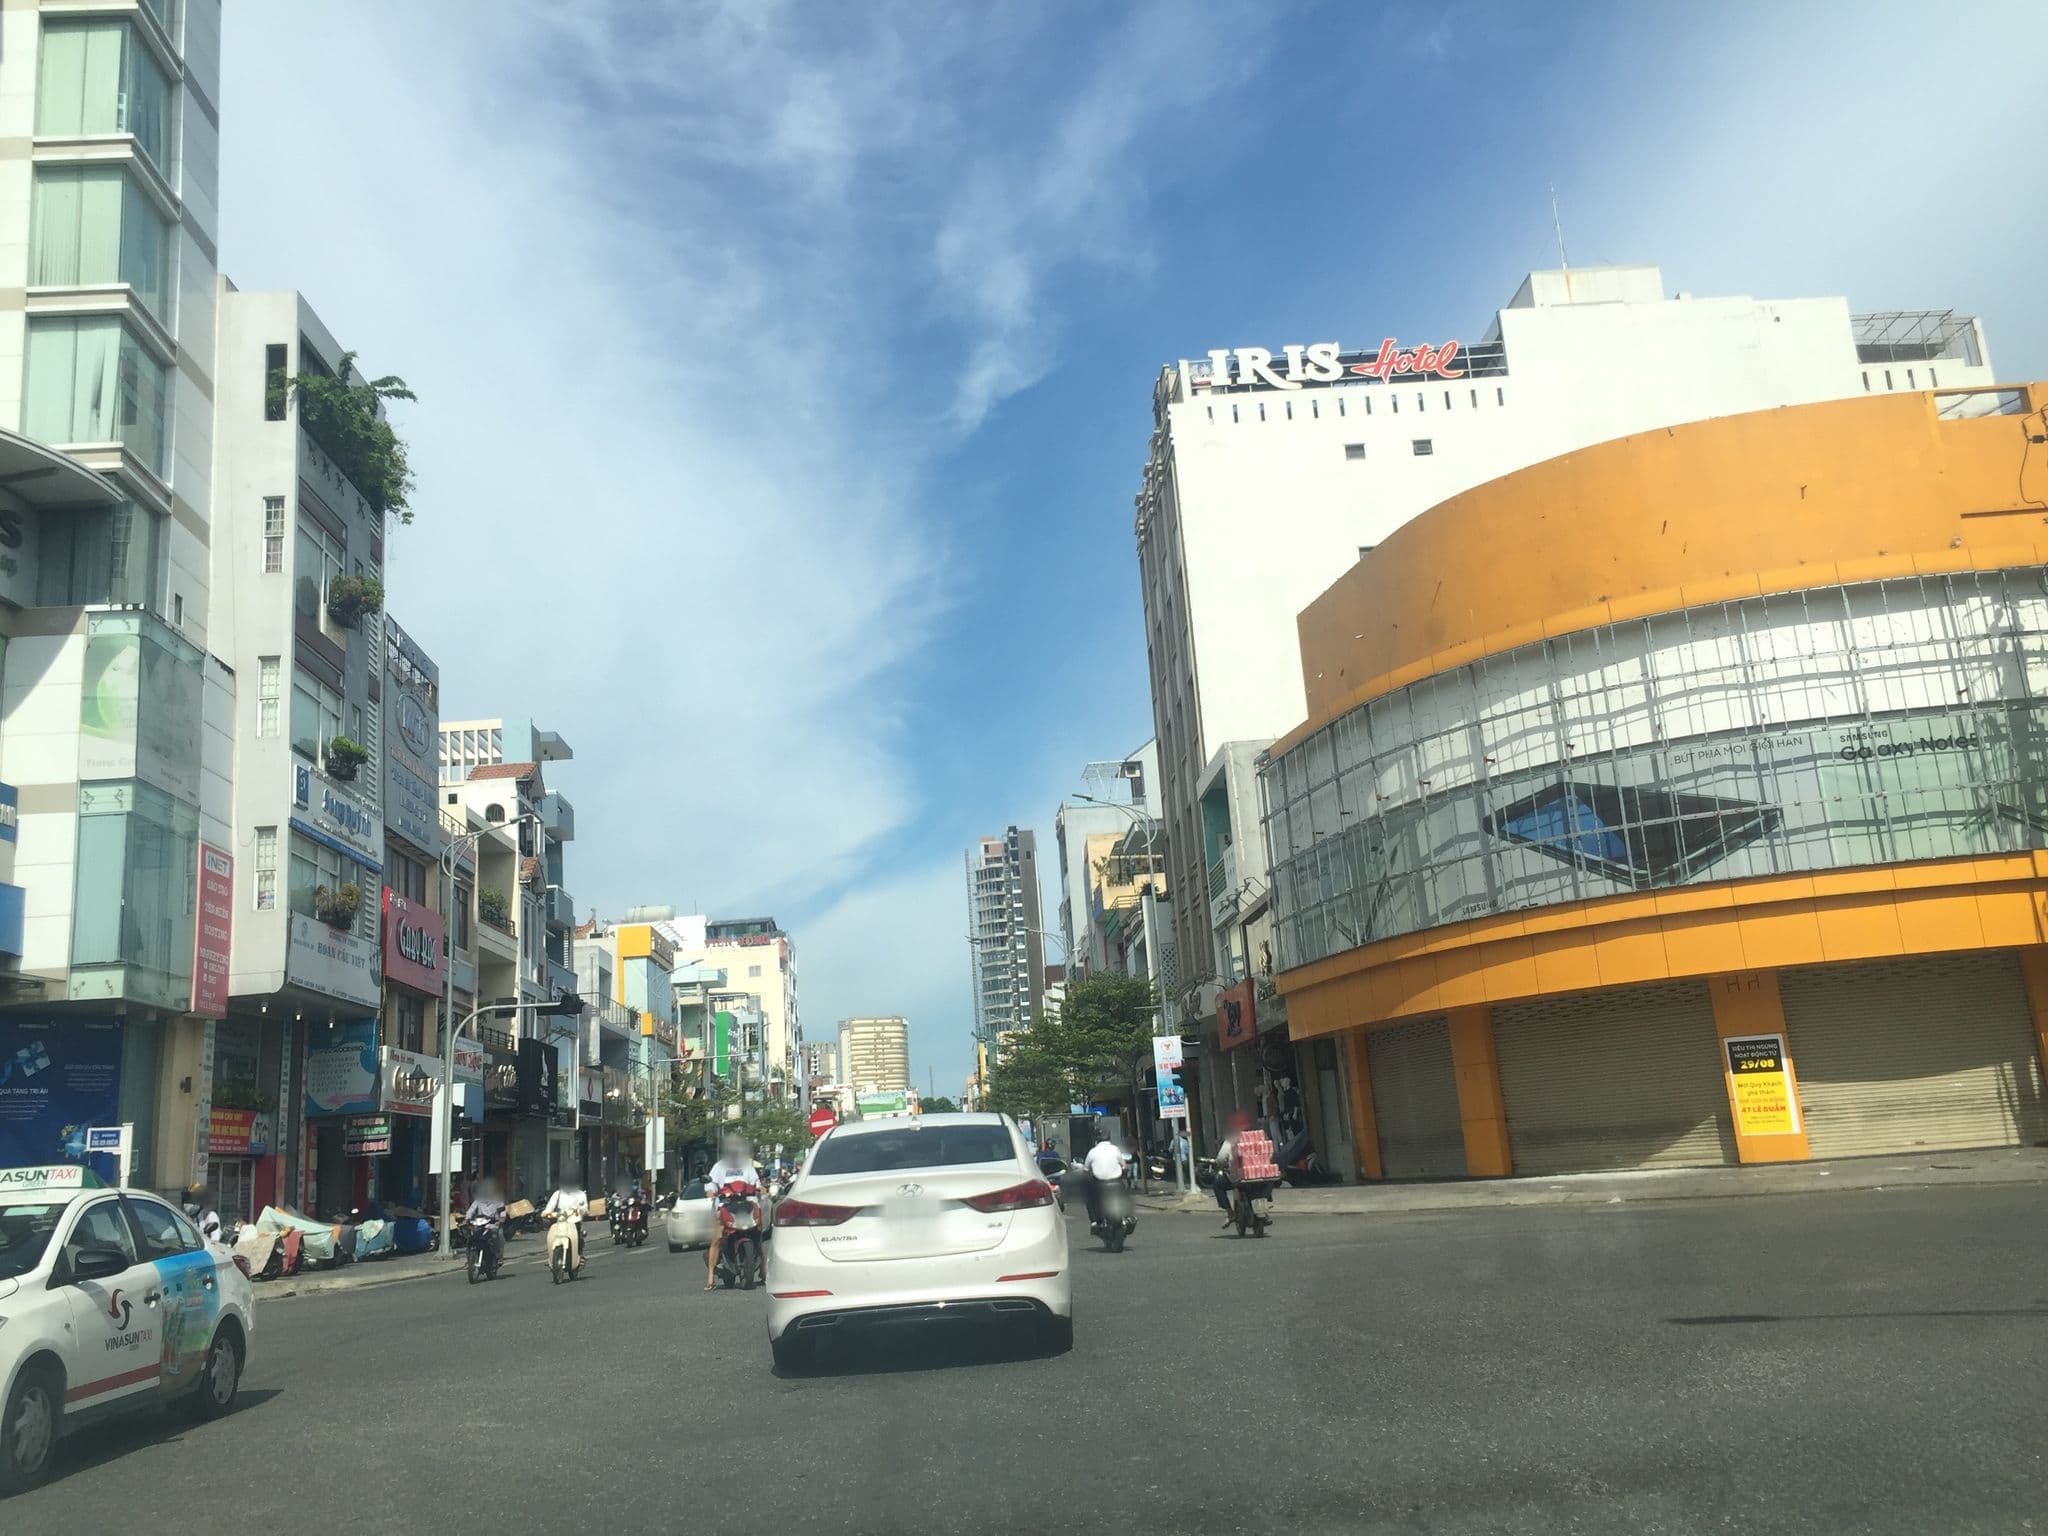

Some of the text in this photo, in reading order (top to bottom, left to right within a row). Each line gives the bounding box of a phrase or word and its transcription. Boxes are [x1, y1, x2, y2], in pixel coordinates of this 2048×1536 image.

[1208, 337, 1465, 390] IRIS Hotel
[1840, 730, 1888, 743] SAMSUNG
[1841, 740, 1914, 760] Gaaxy
[1741, 1059, 1775, 1069] 29/08
